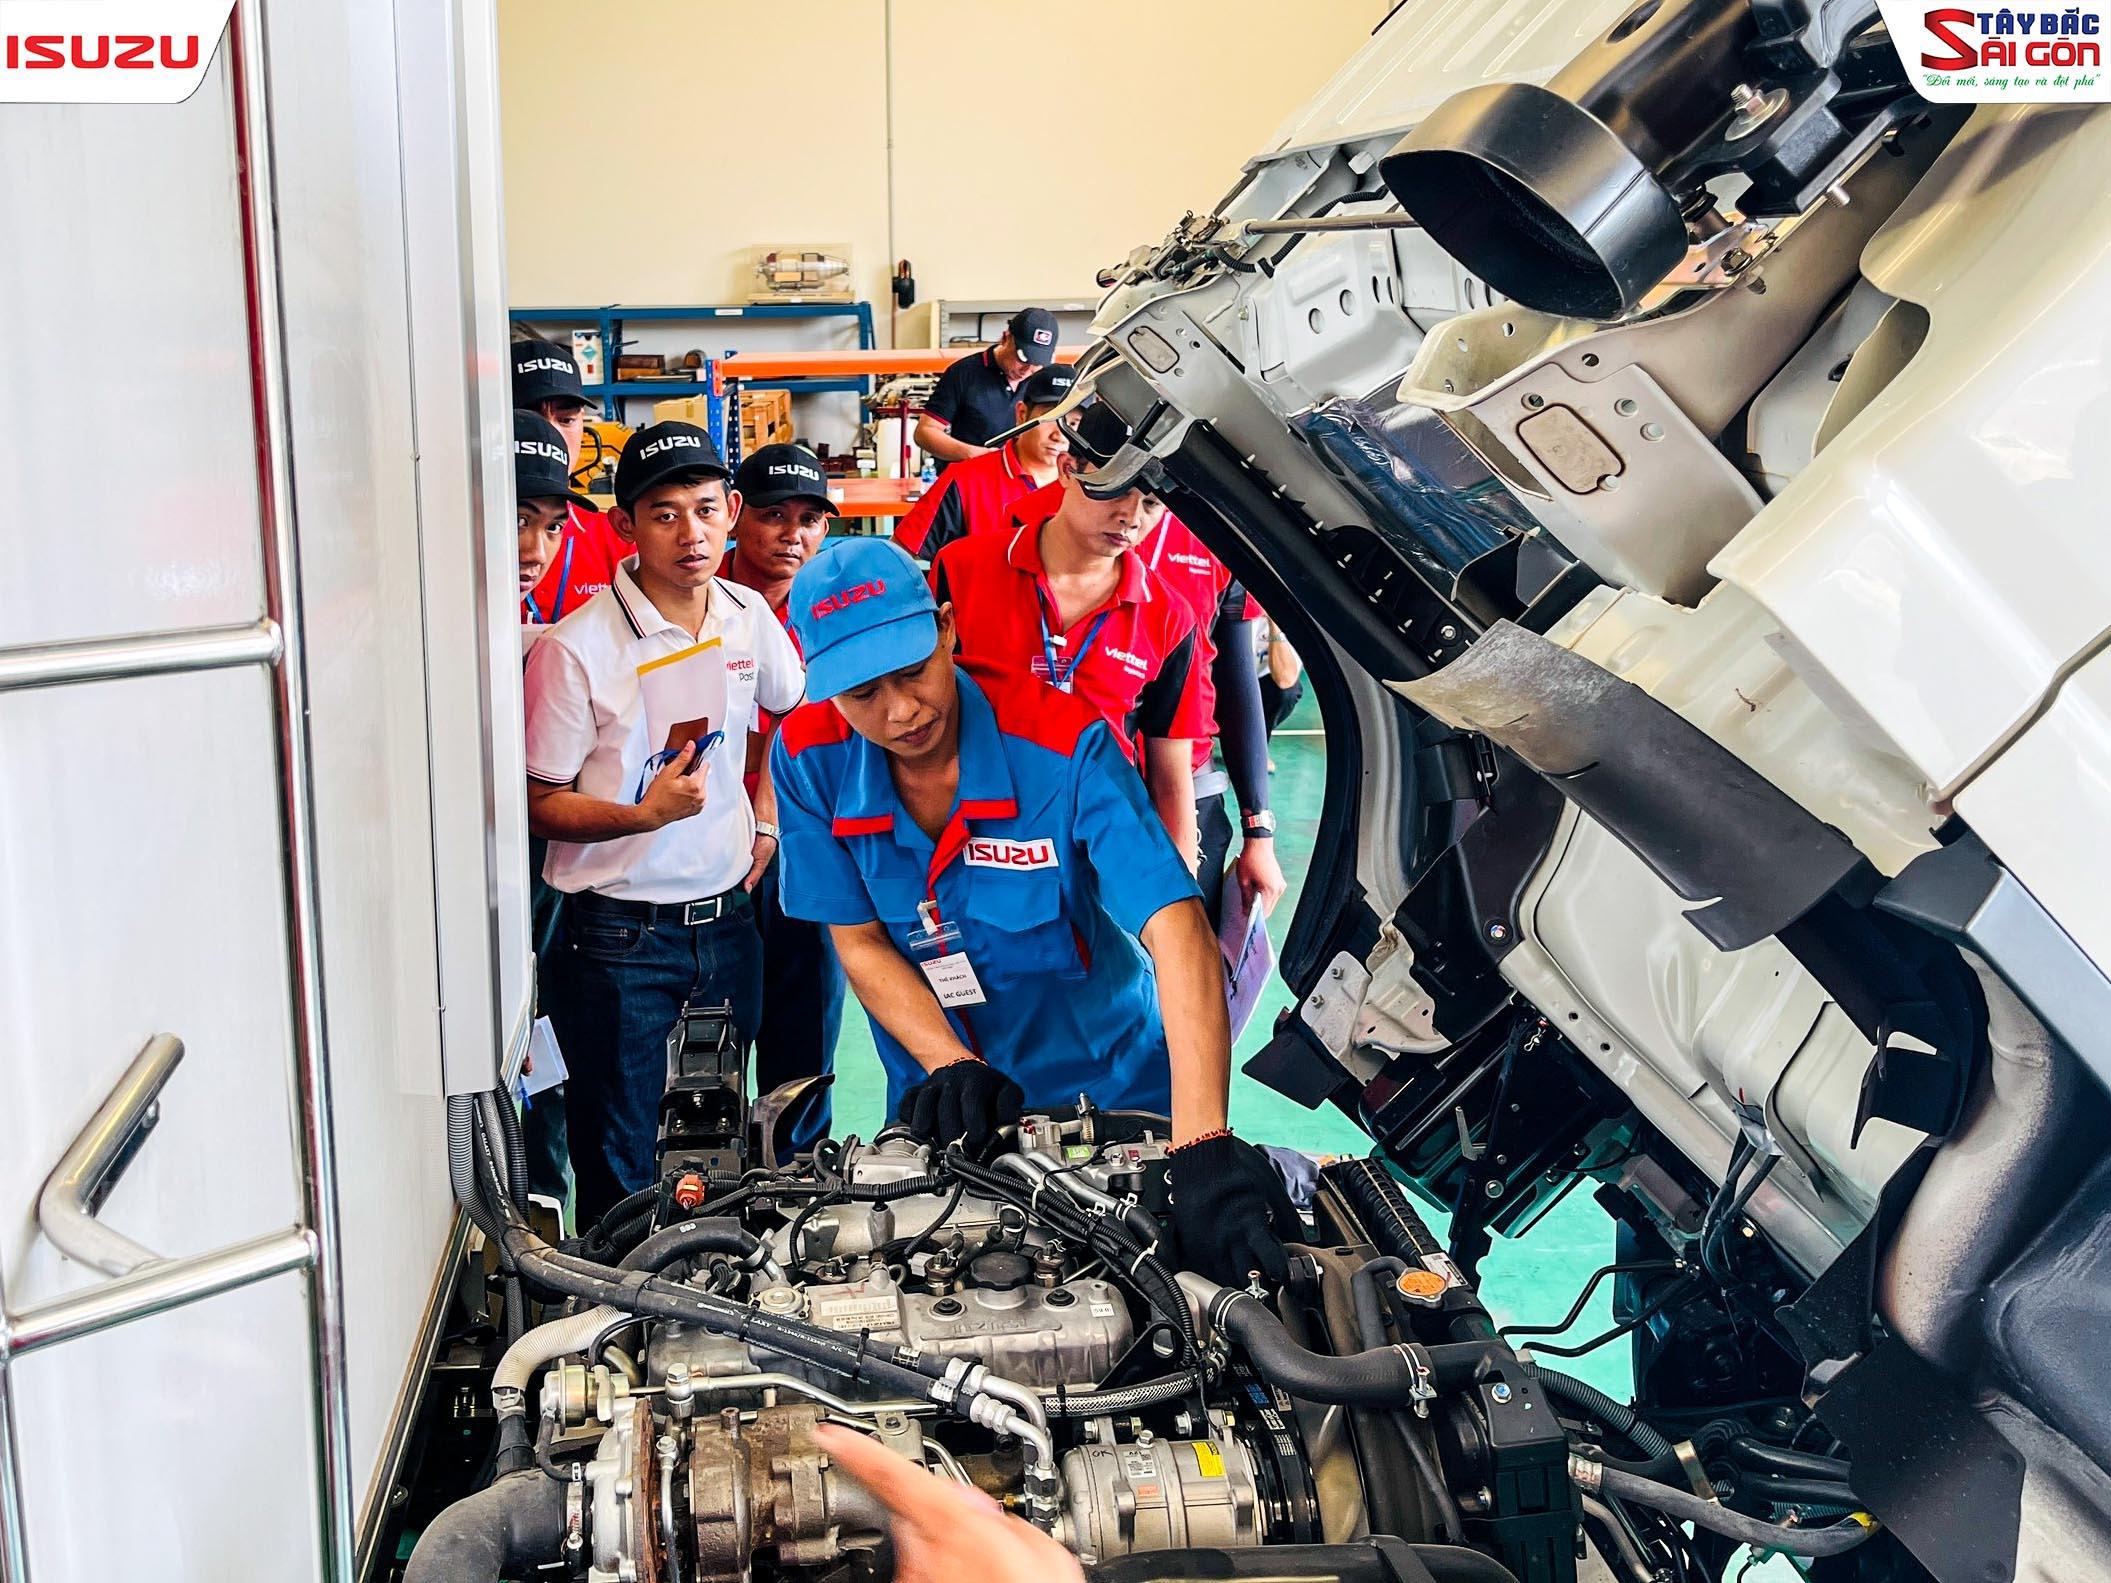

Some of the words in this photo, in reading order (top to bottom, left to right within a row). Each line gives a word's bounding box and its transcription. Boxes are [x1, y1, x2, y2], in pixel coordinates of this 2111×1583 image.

[517, 357, 574, 374] ISUZU
[1052, 377, 1074, 387] ISU
[514, 440, 568, 466] ISUZU
[639, 435, 701, 460] ISUZU
[768, 463, 820, 481] ISUZU
[1167, 552, 1212, 568] viettel
[811, 579, 886, 620] ISUZU
[1105, 646, 1148, 670] viettel
[967, 843, 1049, 866] ISUZU
[955, 988, 977, 997] GUEST
[740, 1313, 773, 1328] GLAXY
